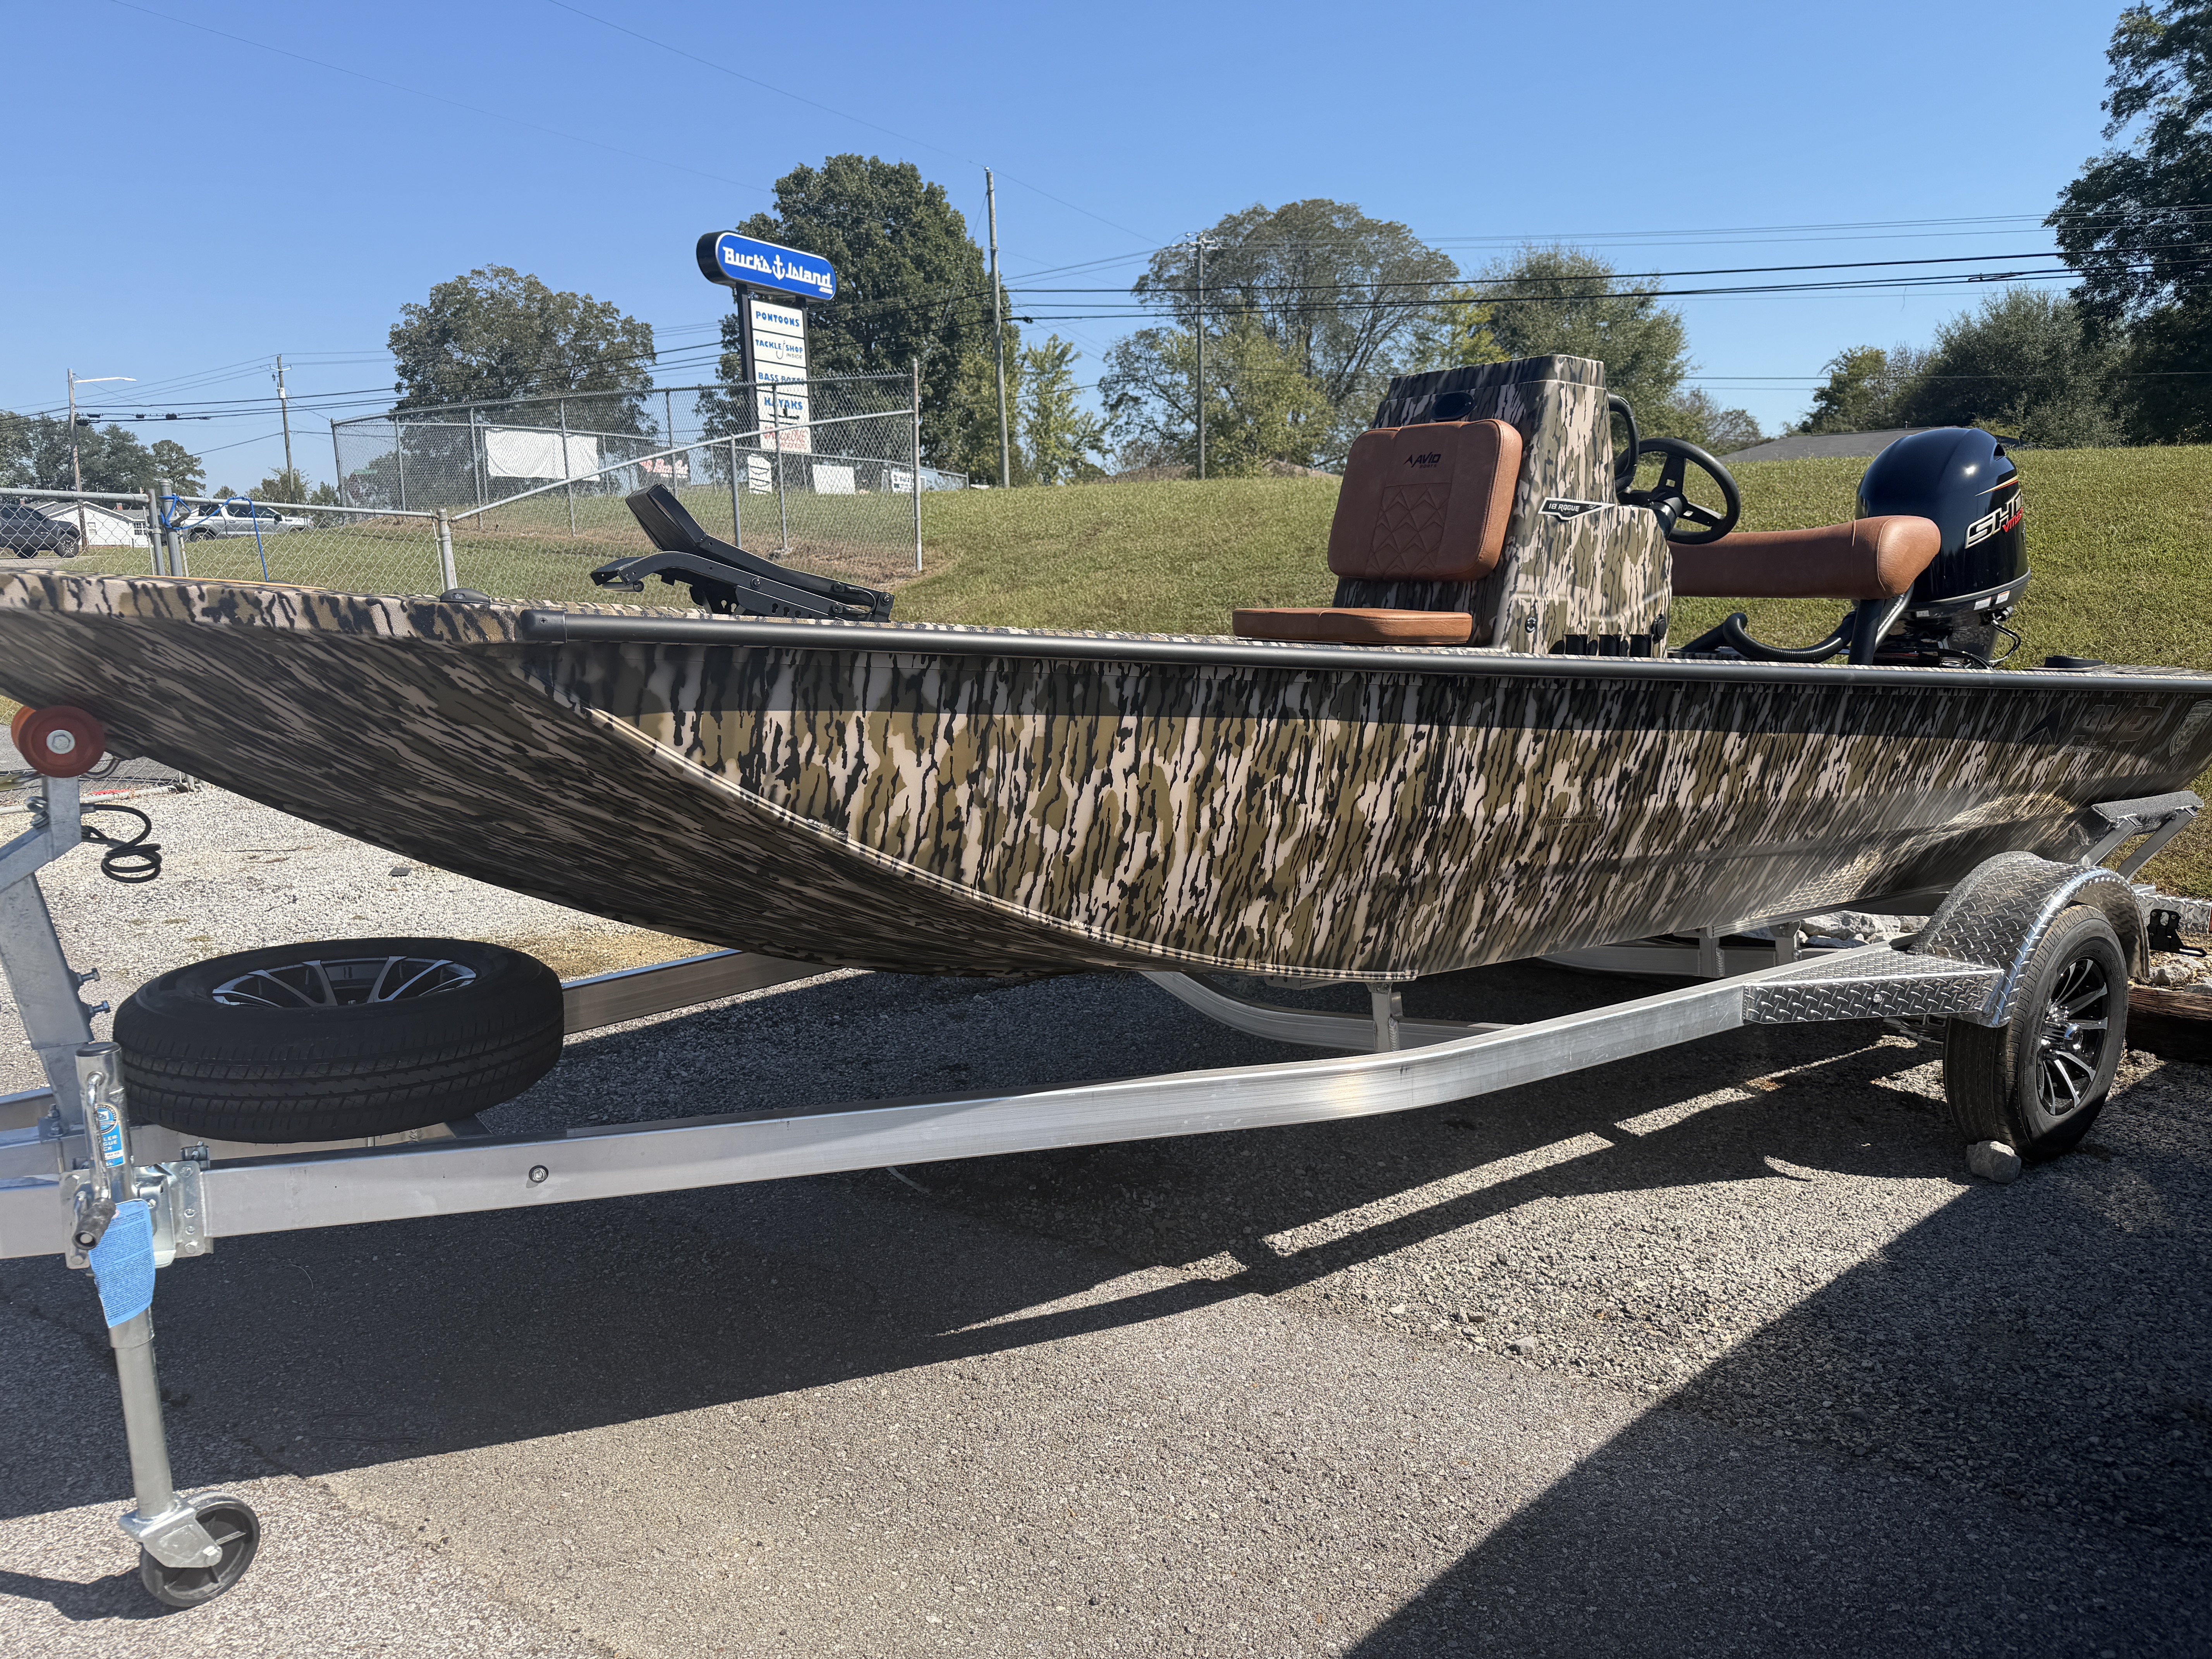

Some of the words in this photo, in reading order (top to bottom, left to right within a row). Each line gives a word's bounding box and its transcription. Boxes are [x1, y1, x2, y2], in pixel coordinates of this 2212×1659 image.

[723, 246, 772, 274] Buck's
[785, 262, 833, 288] Island
[756, 311, 800, 327] PONTOONS
[755, 339, 782, 350] TACKLE
[785, 344, 803, 354] SHOP
[758, 372, 779, 382] BASS
[764, 397, 803, 410] KYAKS
[1558, 504, 1580, 512] ROGUE
[1547, 816, 1598, 826] BOTTOMLAND
